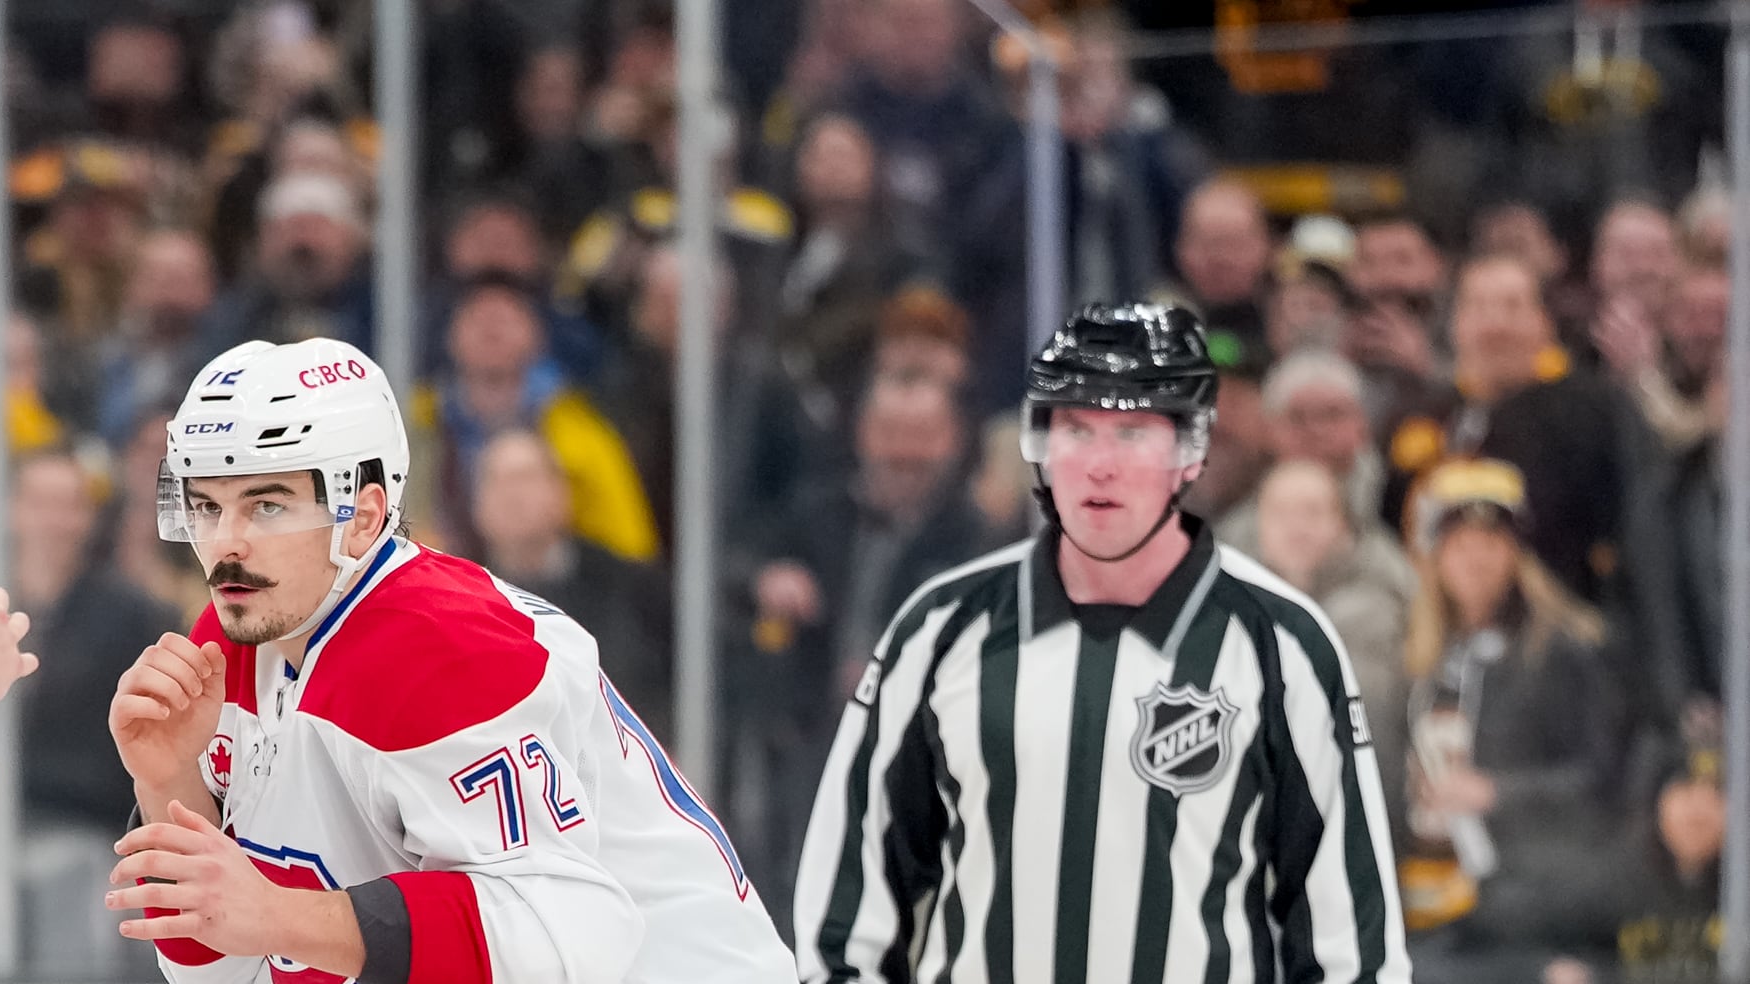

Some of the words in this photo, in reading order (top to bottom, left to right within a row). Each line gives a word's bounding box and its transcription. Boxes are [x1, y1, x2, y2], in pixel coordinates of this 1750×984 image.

[184, 422, 235, 435] CCM
[1152, 715, 1217, 769] NHL
[449, 734, 585, 851] 72
